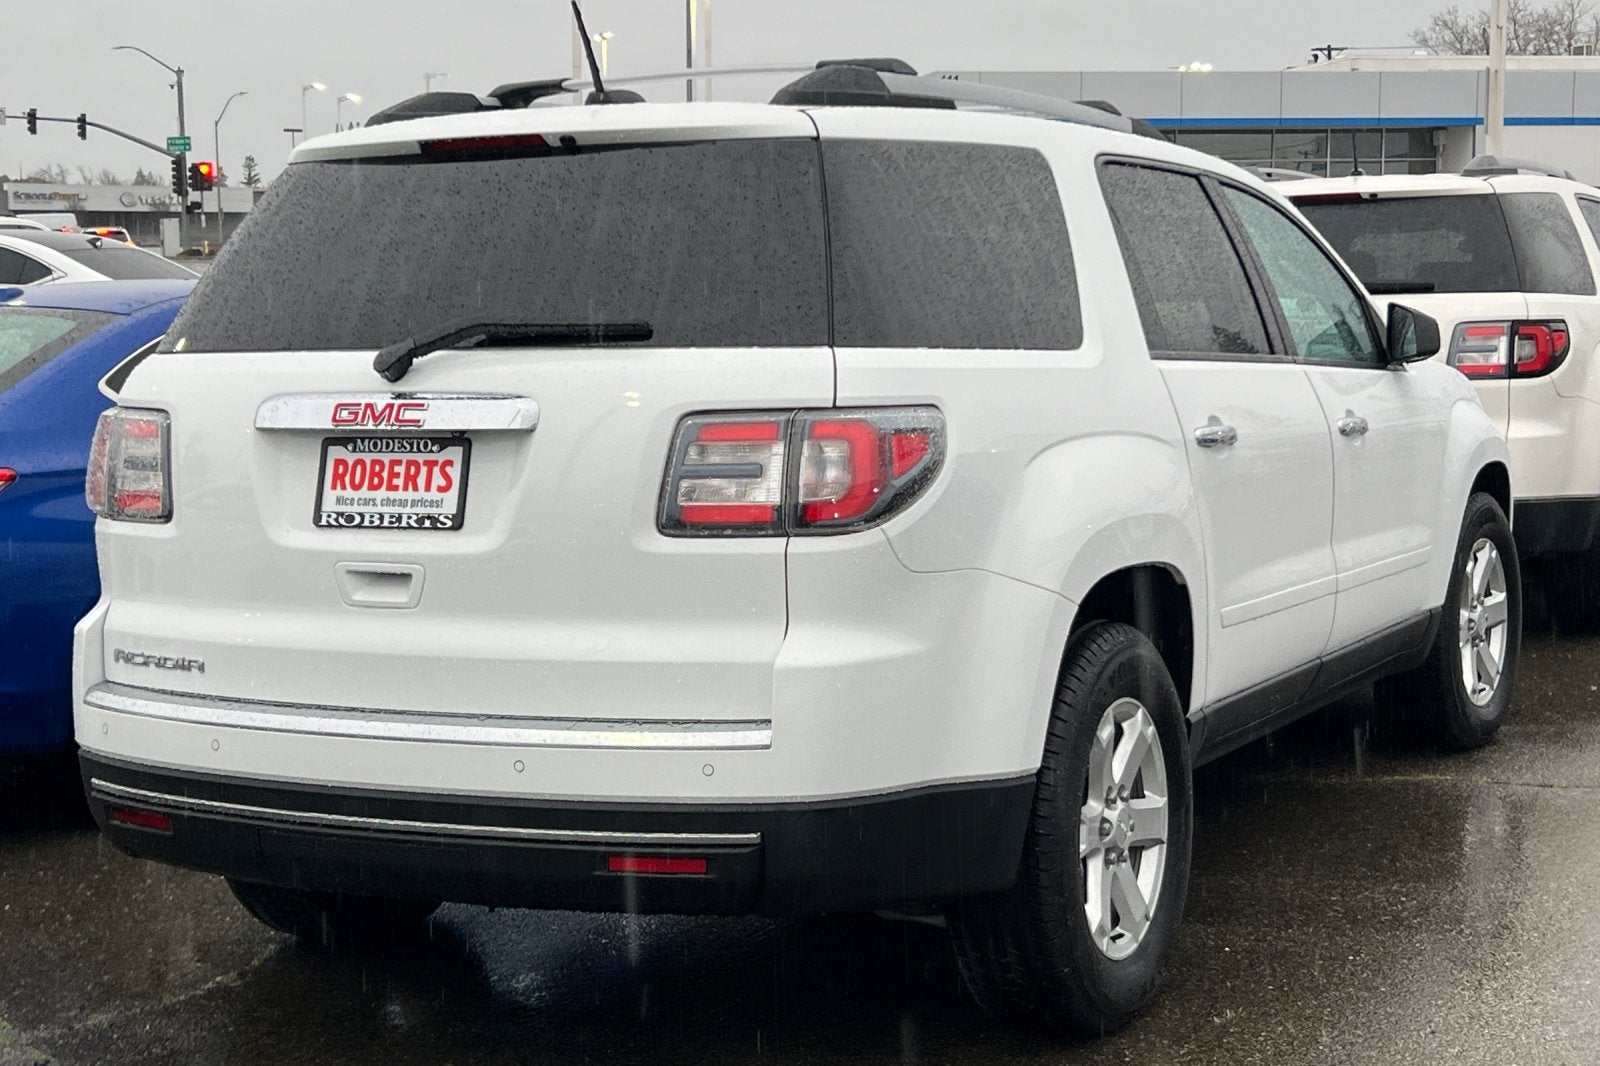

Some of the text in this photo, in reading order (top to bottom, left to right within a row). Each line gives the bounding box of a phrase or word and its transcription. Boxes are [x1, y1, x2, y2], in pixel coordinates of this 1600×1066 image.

[331, 402, 428, 427] GMC
[355, 438, 432, 452] MODESTO
[330, 458, 455, 494] ROBERTS
[335, 495, 444, 510] Nice cars, cheap prices!
[318, 512, 453, 528] ROBERTS
